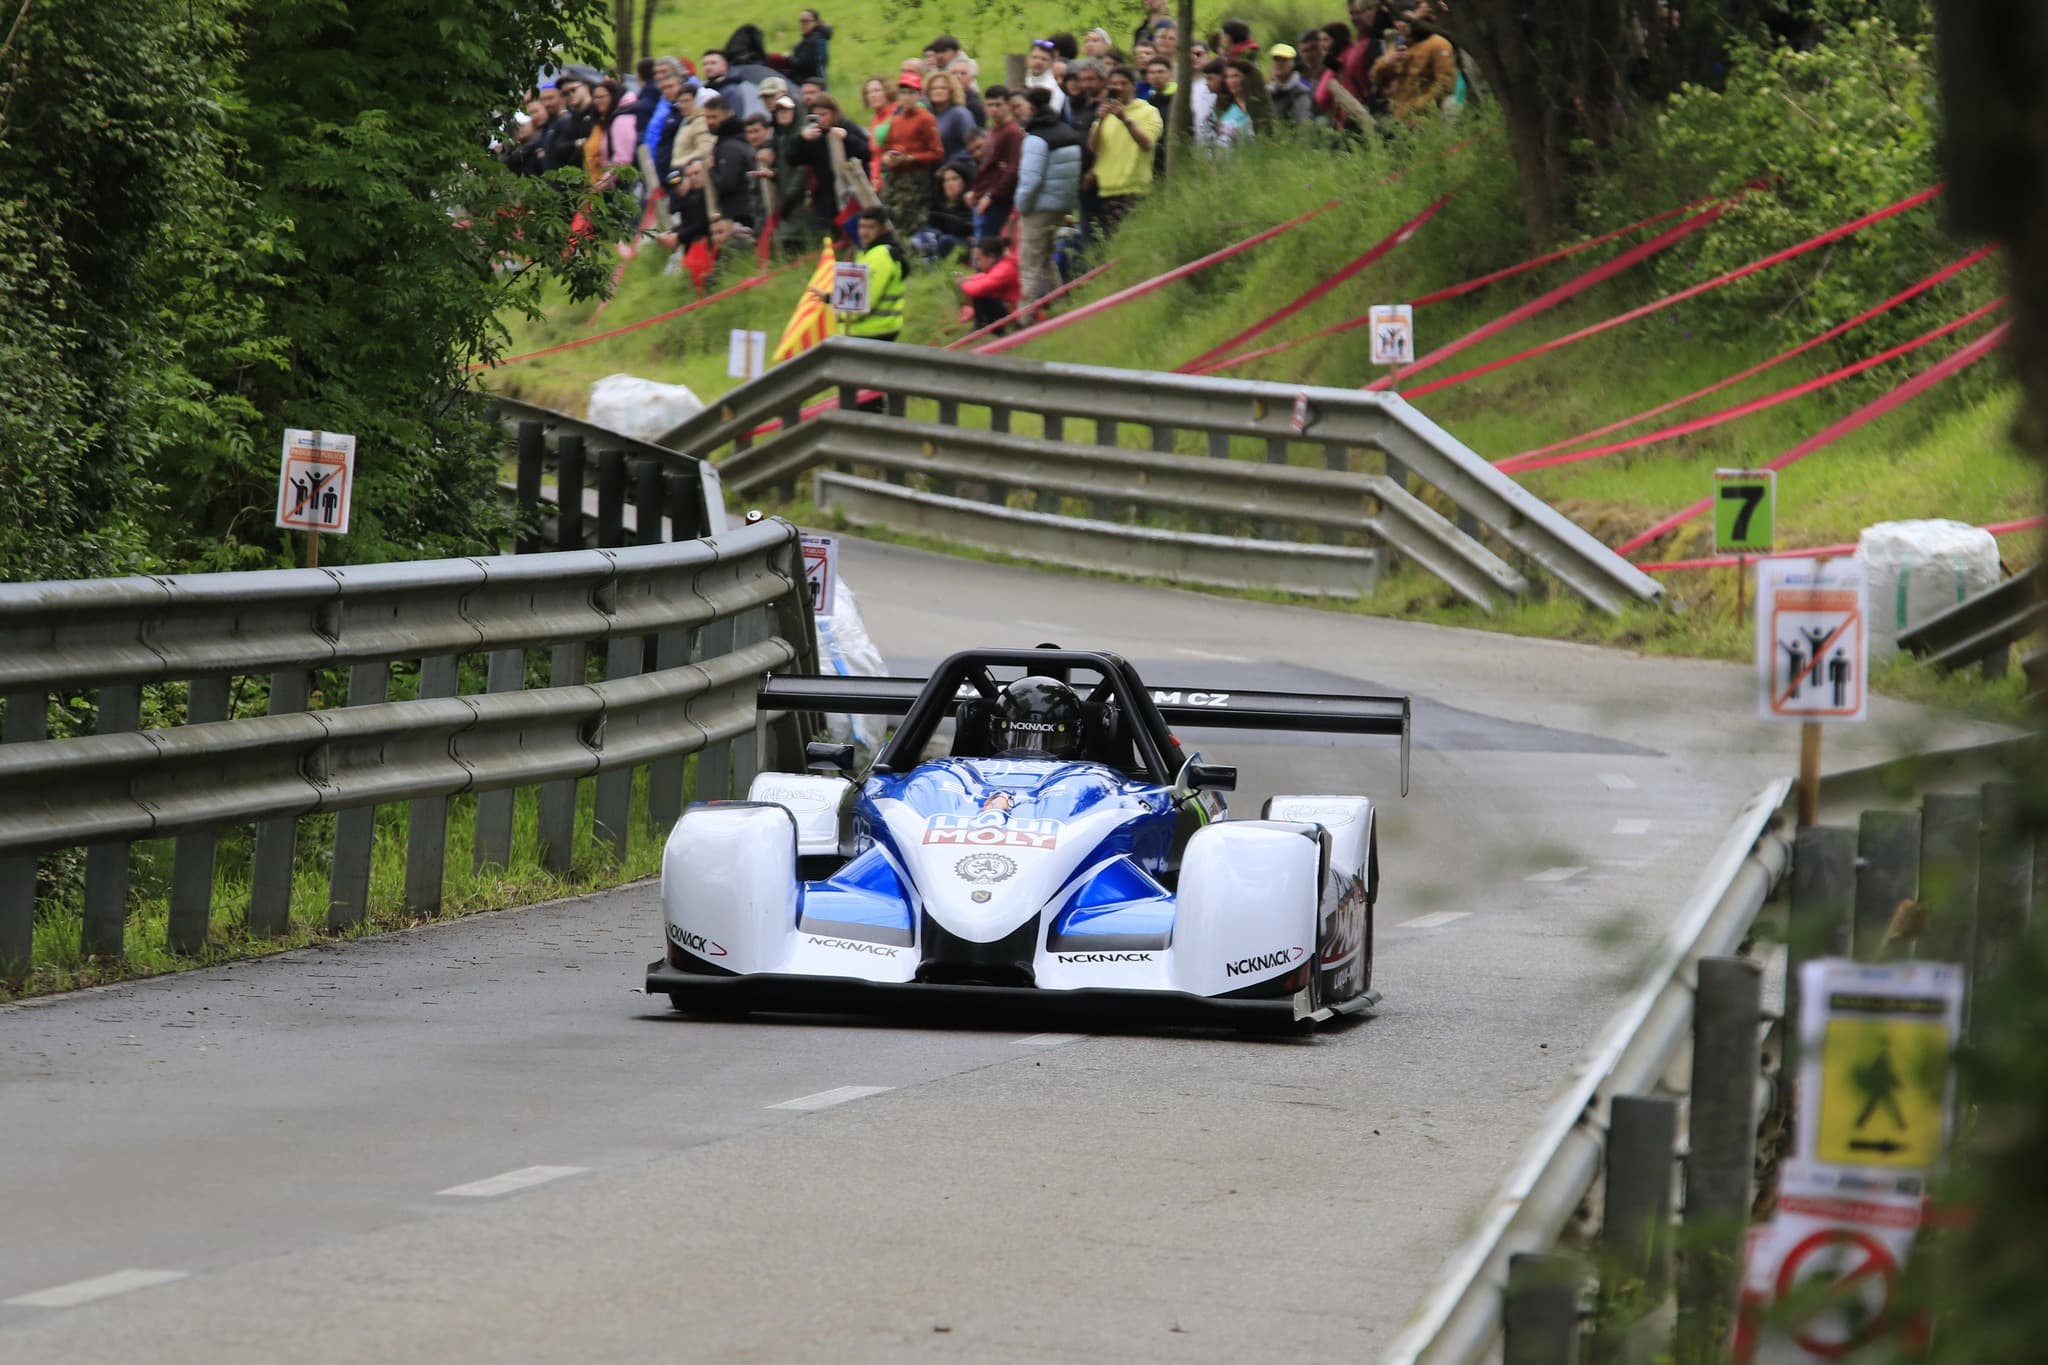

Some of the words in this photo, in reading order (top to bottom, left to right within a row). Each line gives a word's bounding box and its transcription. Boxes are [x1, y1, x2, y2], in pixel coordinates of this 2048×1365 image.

[1721, 485, 1765, 541] 7
[1187, 692, 1229, 706] CZ
[934, 811, 1053, 835] LIQUI
[928, 828, 1056, 847] MOLY
